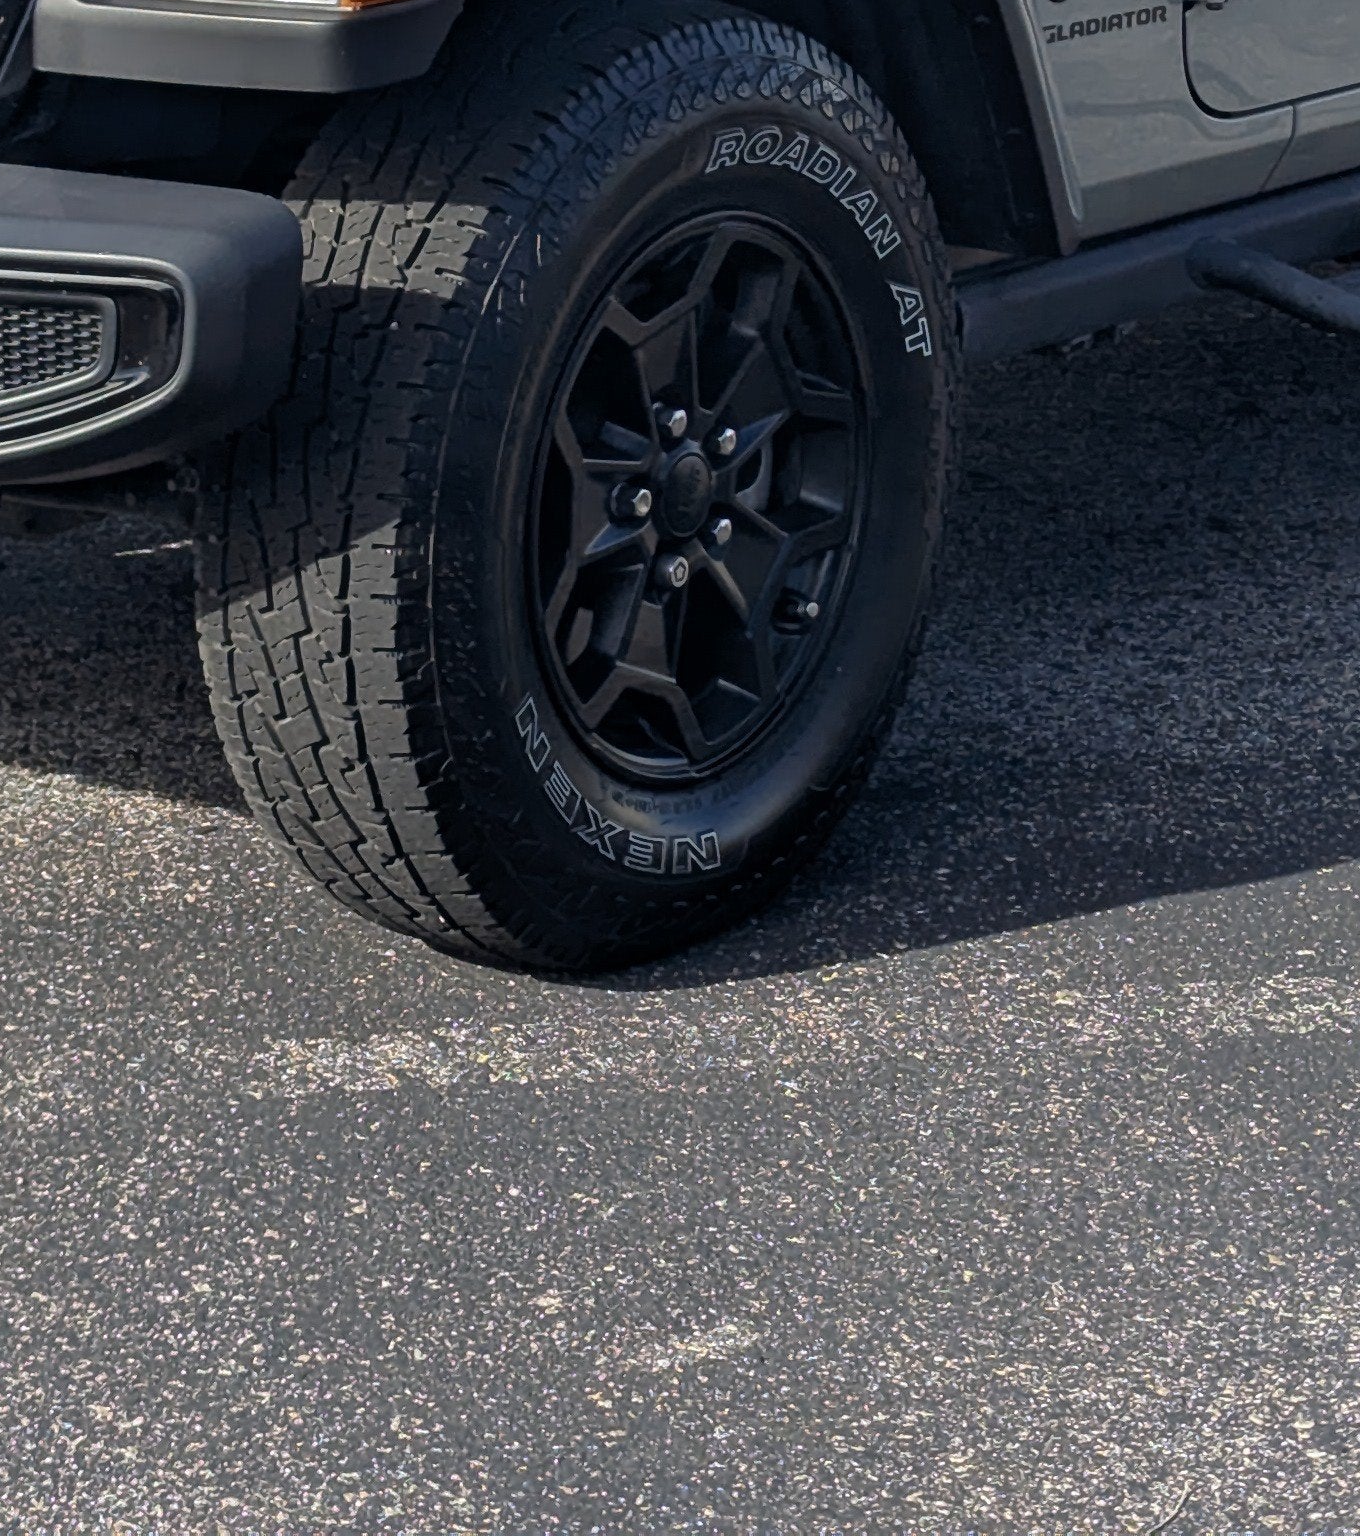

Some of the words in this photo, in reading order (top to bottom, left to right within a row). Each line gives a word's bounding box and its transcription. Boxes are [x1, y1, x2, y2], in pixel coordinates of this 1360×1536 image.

[1042, 5, 1167, 44] GLADIATOR
[705, 125, 902, 260] ROADIAN
[887, 280, 932, 357] AT
[515, 695, 721, 874] NEXEN
